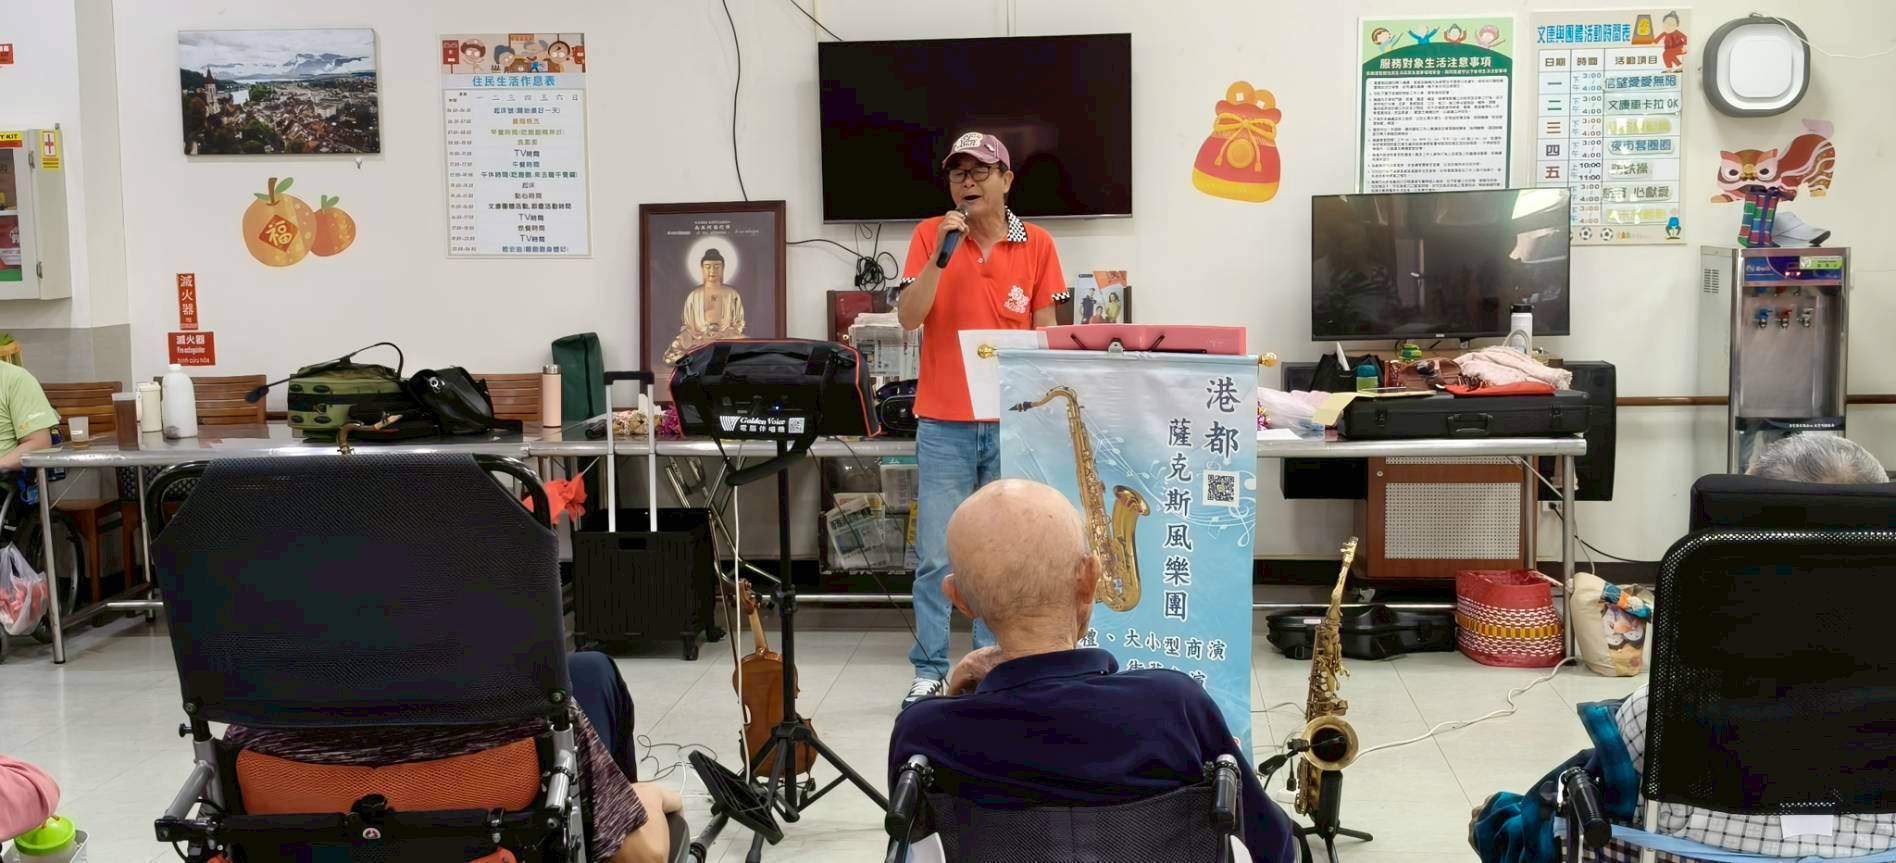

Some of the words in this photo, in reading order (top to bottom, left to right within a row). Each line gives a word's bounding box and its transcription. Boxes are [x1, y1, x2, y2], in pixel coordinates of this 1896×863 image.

[1380, 56, 1492, 69] 服務對象生活注意事項
[1545, 57, 1566, 67] 日期
[1576, 56, 1598, 66] 時間
[1615, 55, 1658, 65] 活動項目
[472, 75, 556, 87] 住民生活作息表
[1547, 100, 1562, 111] 二
[1546, 121, 1561, 134] 三
[1546, 144, 1560, 156] 四
[1545, 166, 1560, 179] 五
[265, 220, 293, 247] 福
[180, 275, 195, 316] 滅火器
[176, 335, 205, 345] 滅火器
[740, 416, 767, 425] Golden
[767, 416, 786, 425] Voice
[1203, 376, 1241, 460] 港都
[1164, 417, 1193, 621] 薩克斯風樂團
